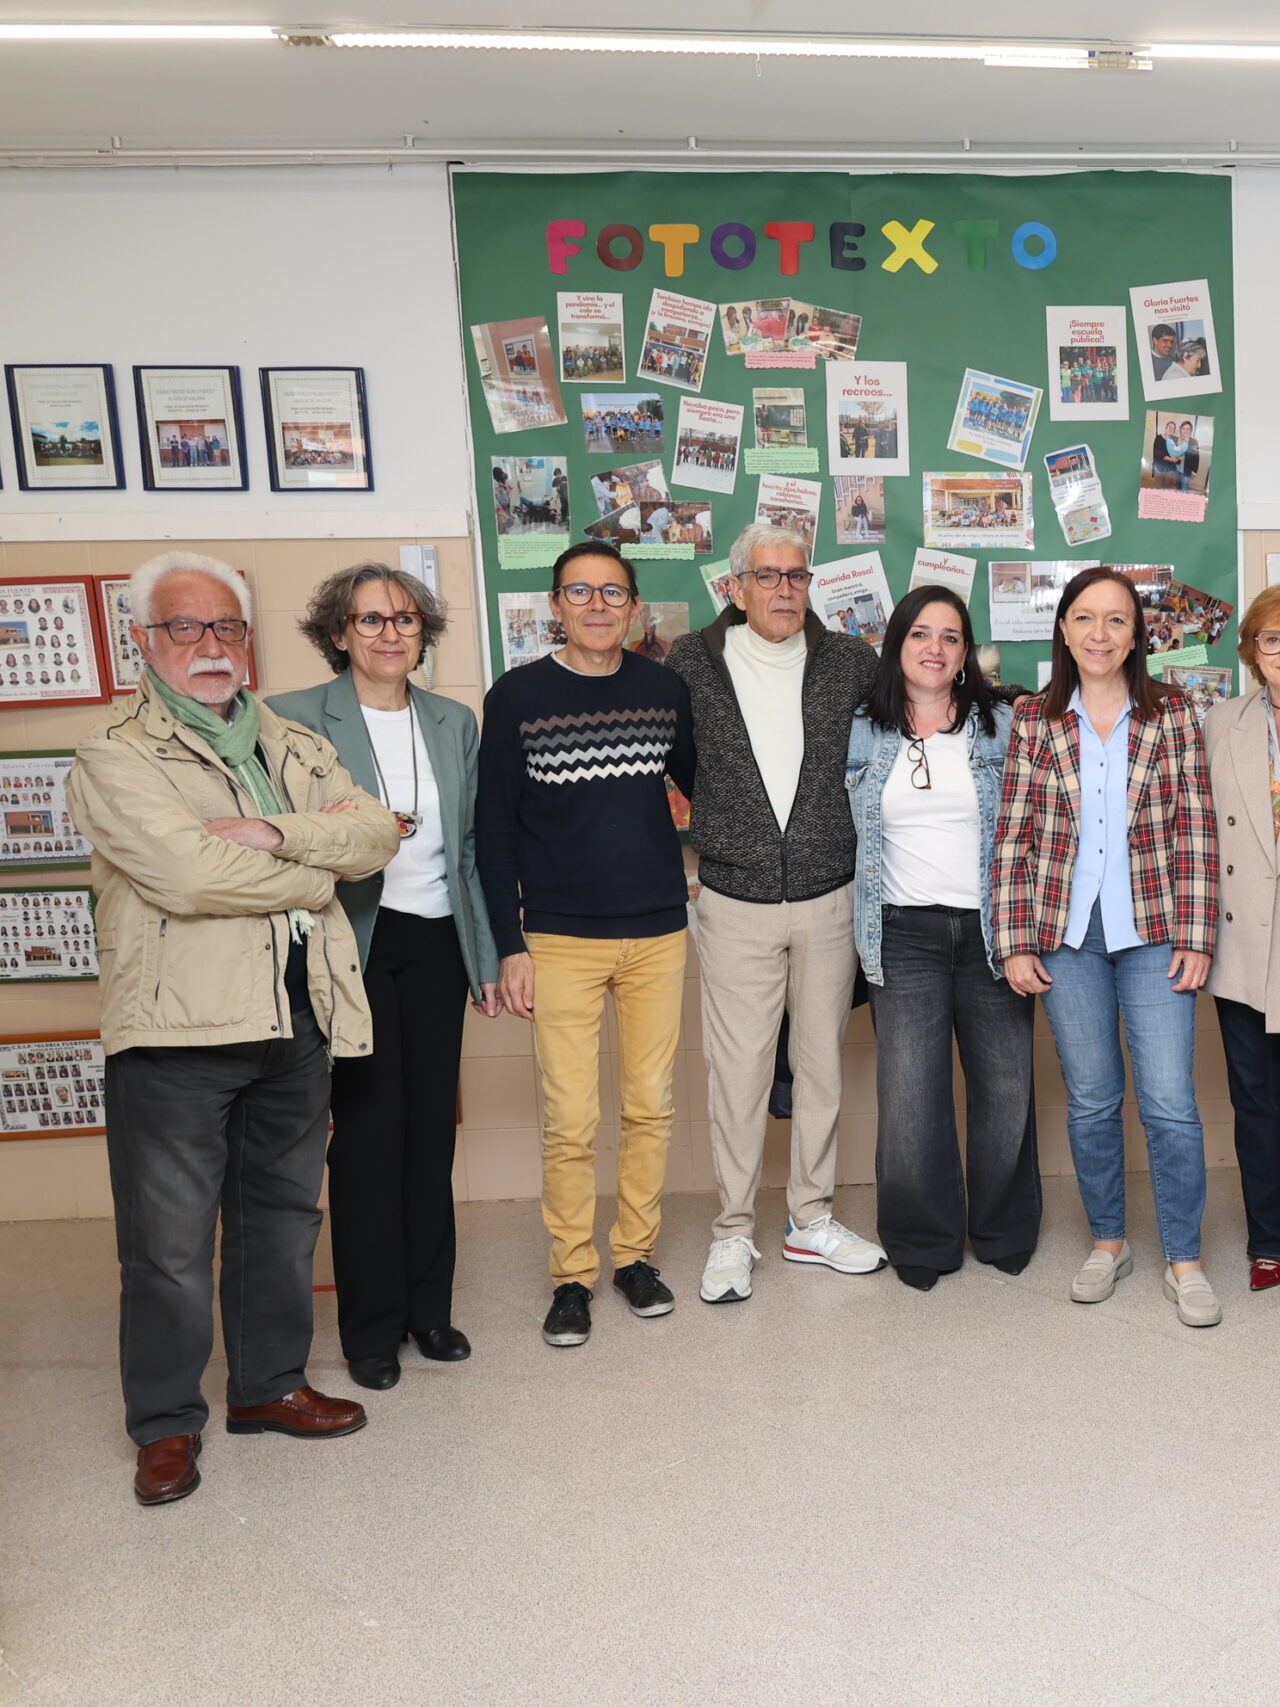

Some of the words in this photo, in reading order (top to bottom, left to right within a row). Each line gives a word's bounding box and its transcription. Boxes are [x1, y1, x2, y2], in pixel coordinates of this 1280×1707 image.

[546, 219, 1058, 277] FOTOTEXTO
[1144, 298, 1169, 308] Gloria
[1170, 296, 1200, 305] Fuertes
[1154, 307, 1169, 315] nos
[1170, 303, 1191, 313] visitó
[1069, 319, 1105, 329] ¡Siempre
[853, 375, 863, 387] Y
[865, 375, 881, 387] los
[842, 387, 893, 398] recreos...
[683, 400, 708, 410] Nevaba
[943, 557, 949, 565] y
[817, 572, 851, 588] ¡Querida
[851, 565, 874, 579] Rosa!
